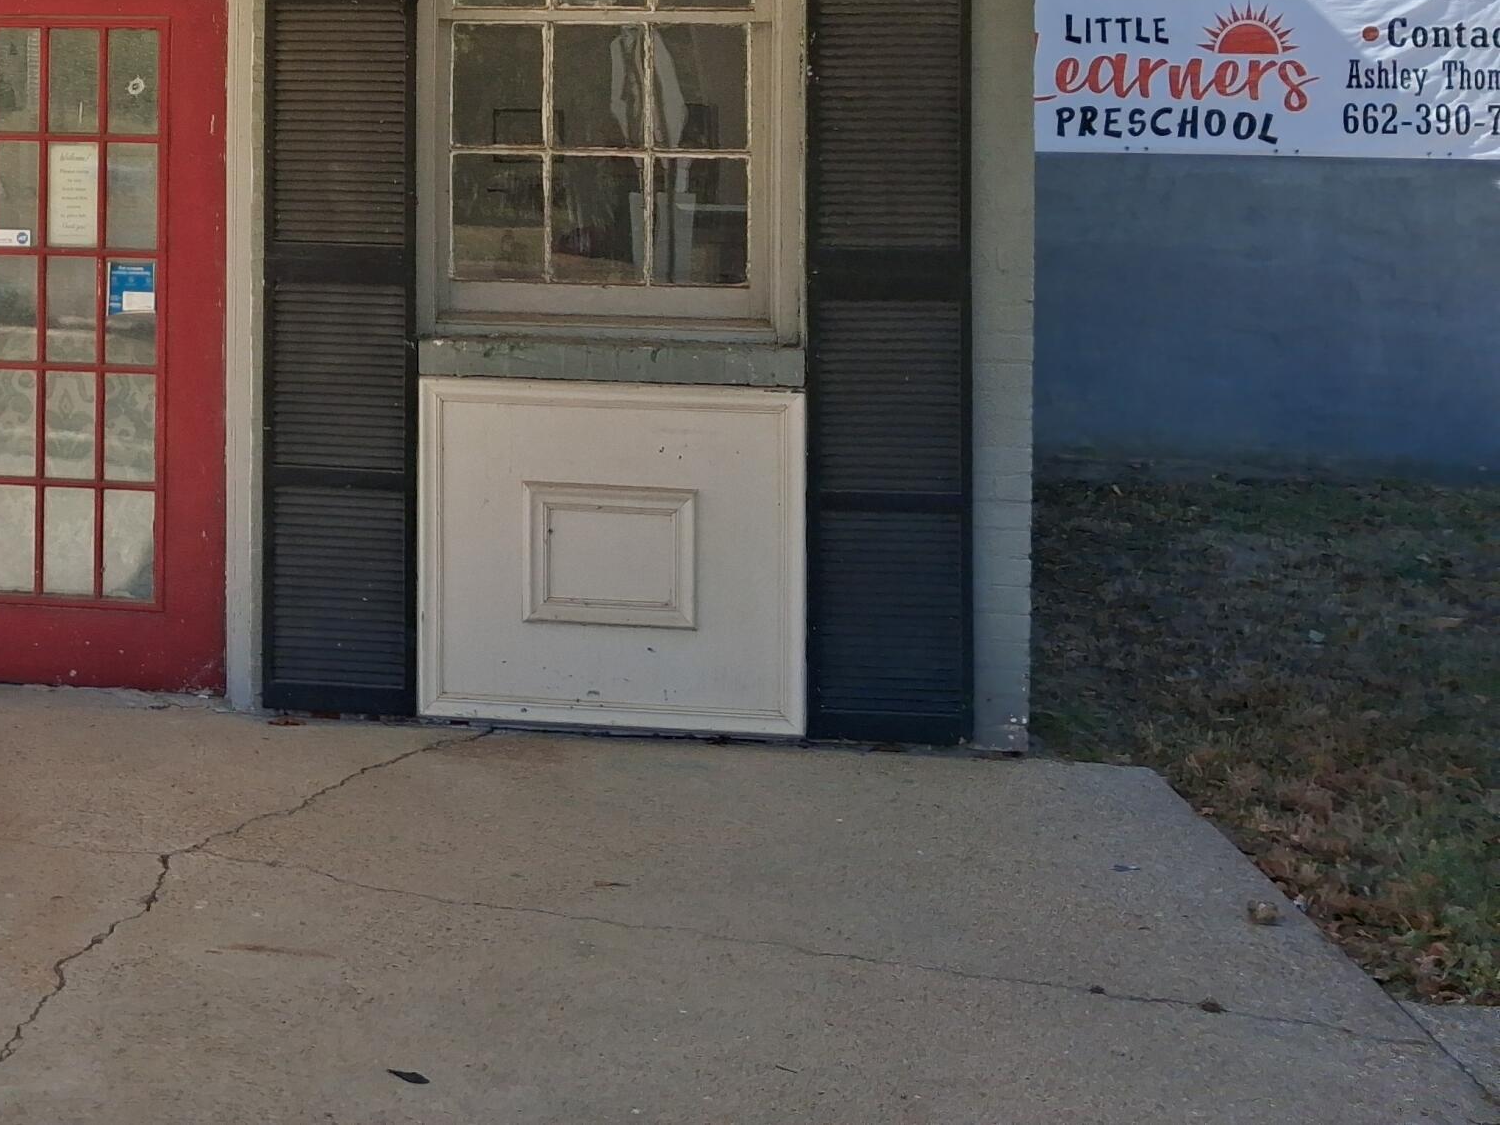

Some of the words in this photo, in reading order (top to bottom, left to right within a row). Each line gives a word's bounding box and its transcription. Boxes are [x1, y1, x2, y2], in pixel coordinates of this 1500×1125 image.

[1065, 14, 1170, 45] LITTLE
[1034, 33, 1320, 112] earners
[1345, 59, 1429, 97] Ashley
[1055, 106, 1279, 145] PRESCHOOL
[1342, 102, 1500, 136] 662-390-7
